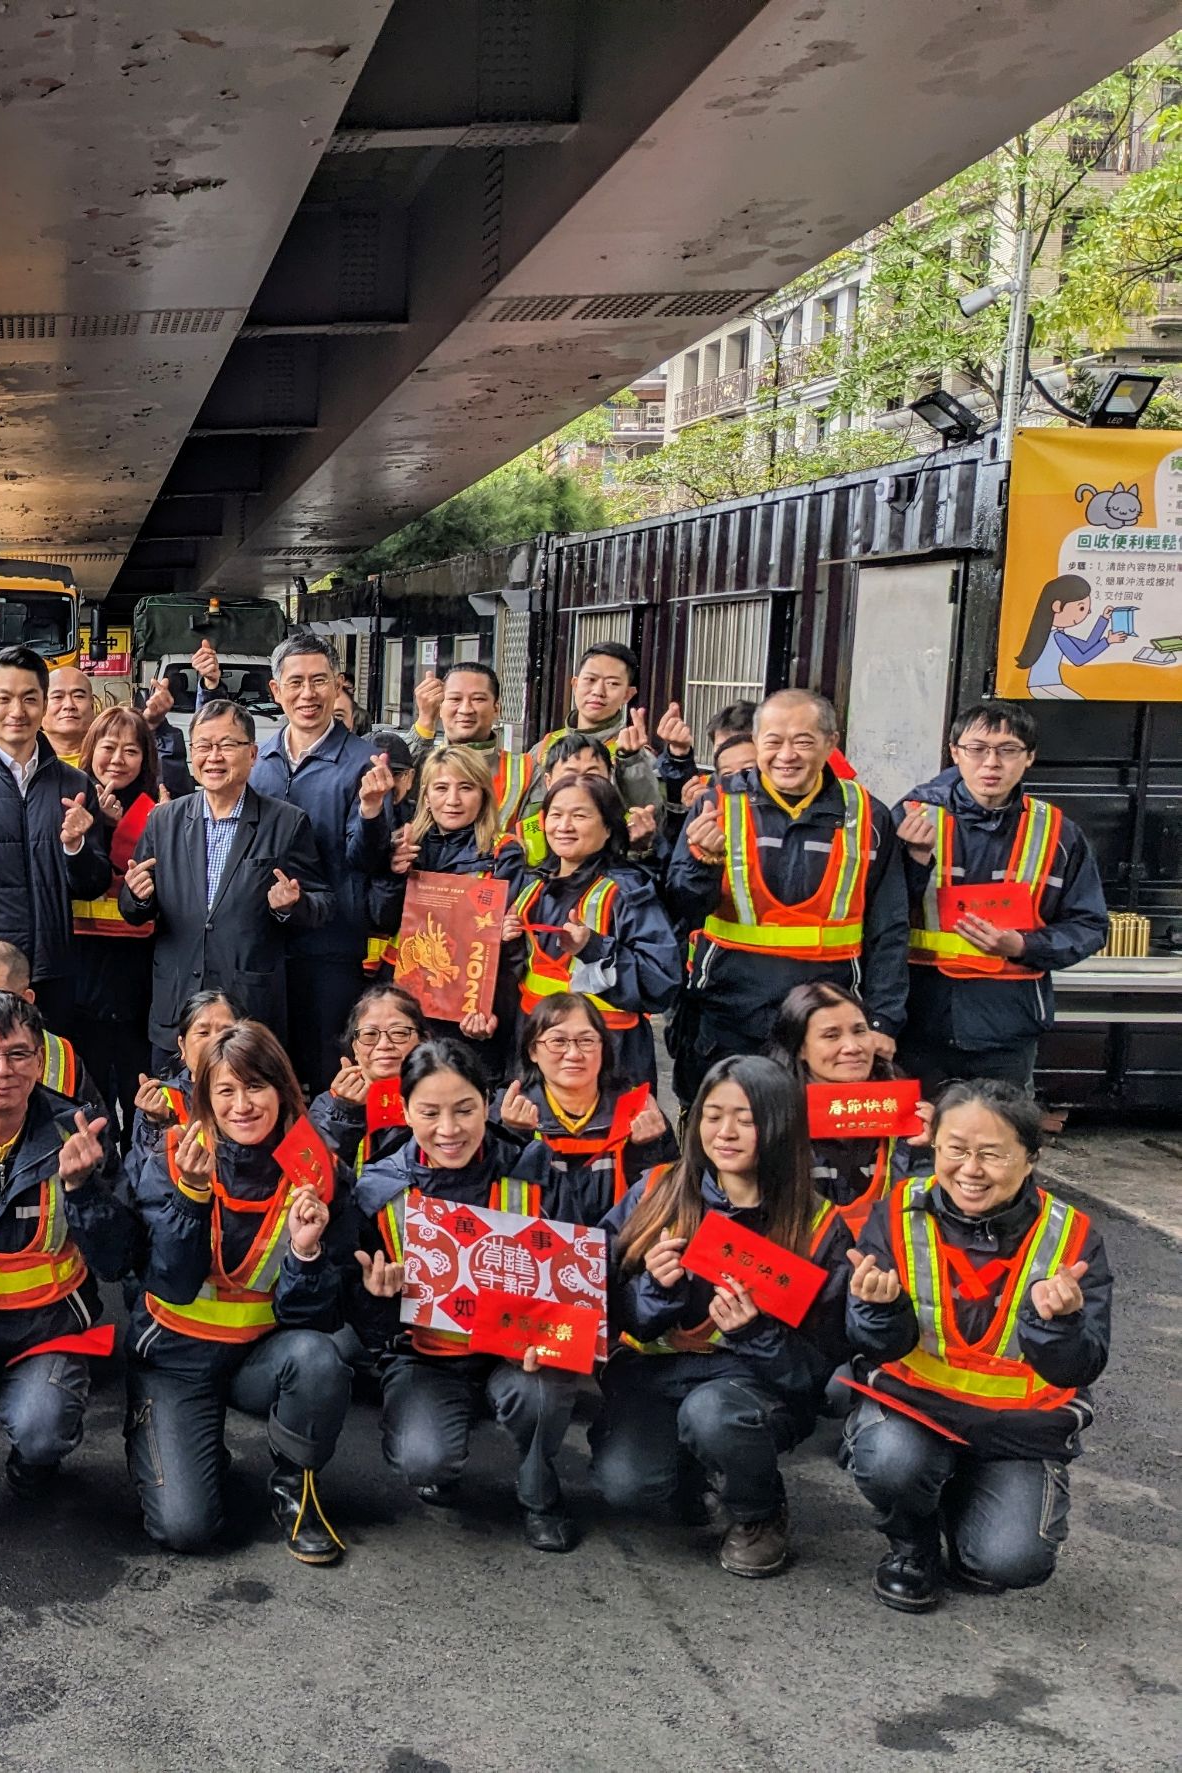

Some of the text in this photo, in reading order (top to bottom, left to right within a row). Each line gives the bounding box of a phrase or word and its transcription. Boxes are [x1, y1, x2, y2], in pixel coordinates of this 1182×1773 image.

[1077, 534, 1182, 551] 回收便利輕鬆
[477, 888, 496, 906] 福
[462, 941, 485, 1013] 2024
[829, 1097, 898, 1116] 春節快樂
[454, 1216, 552, 1250] 萬 事
[453, 1296, 476, 1318] 如
